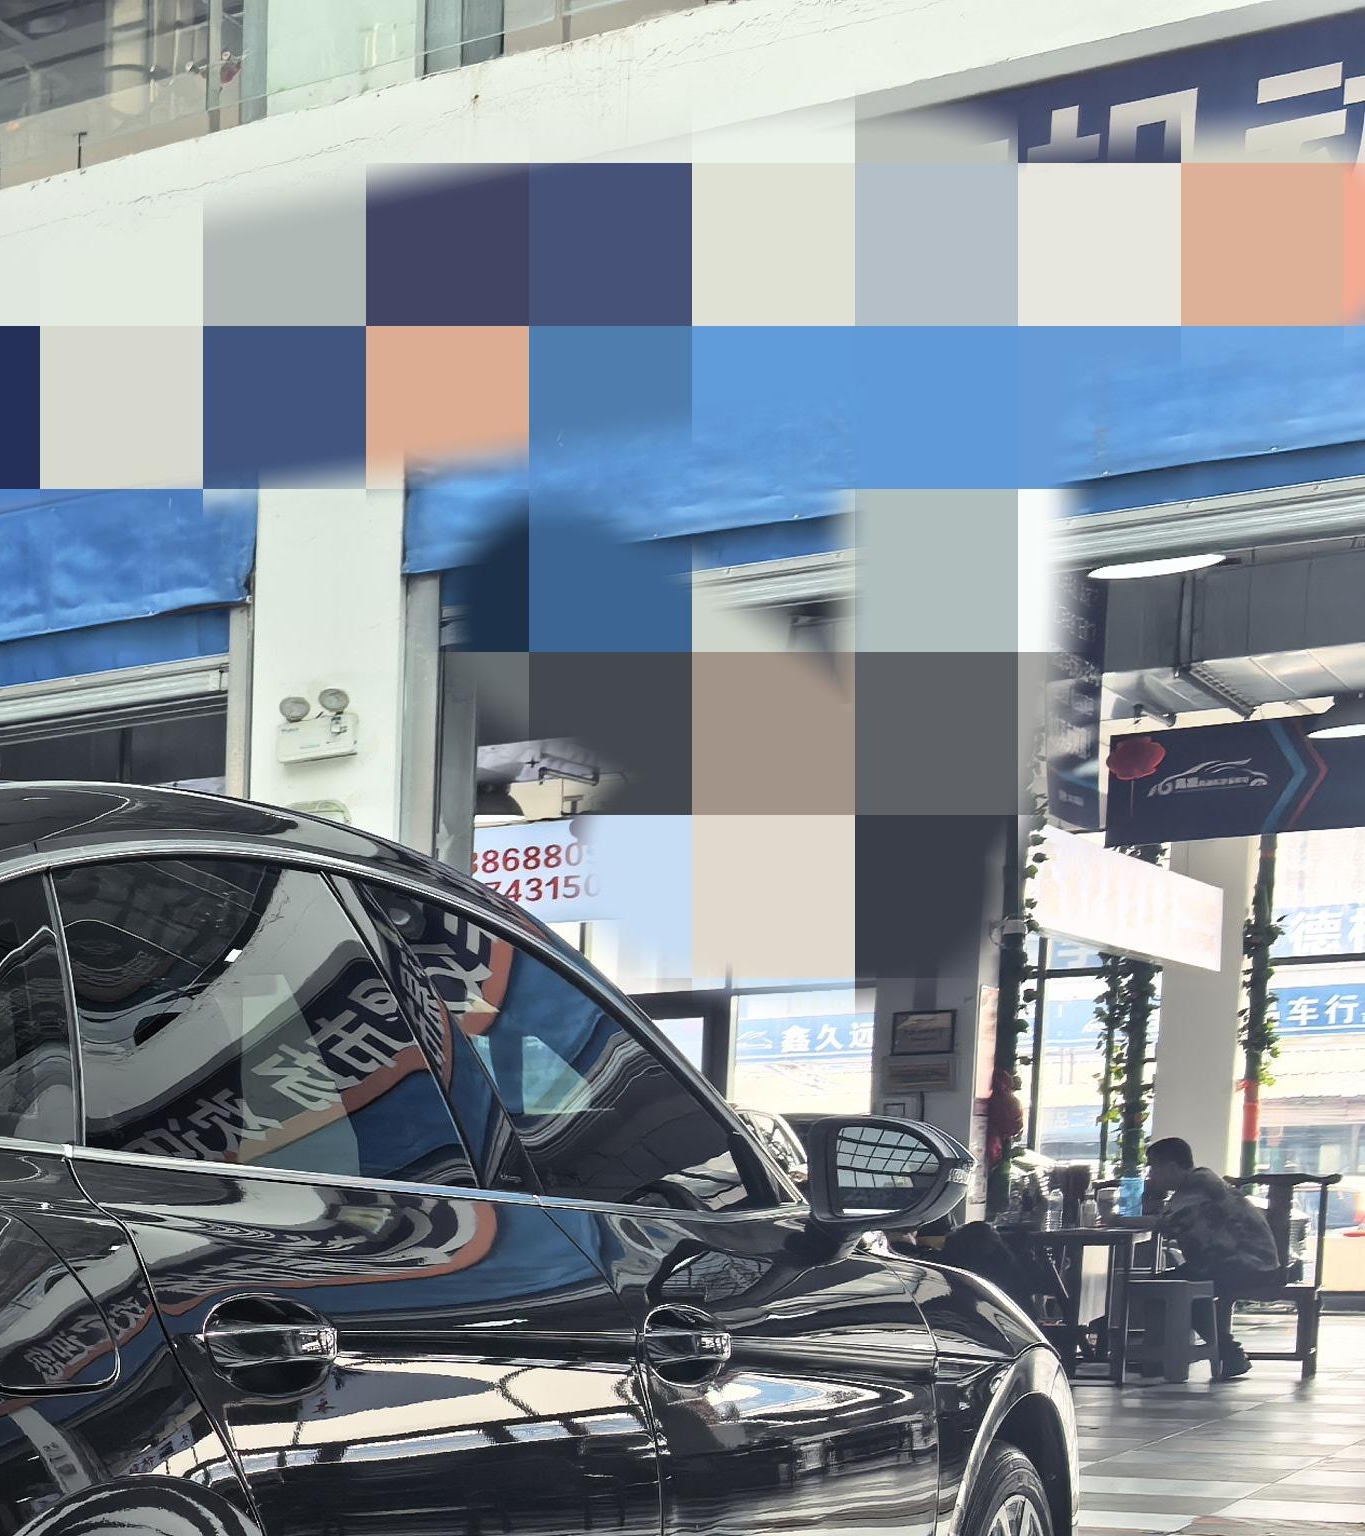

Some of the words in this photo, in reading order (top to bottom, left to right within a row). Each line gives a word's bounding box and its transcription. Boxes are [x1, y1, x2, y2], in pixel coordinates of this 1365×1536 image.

[1266, 994, 1365, 1028] 车行
[780, 1021, 874, 1054] 鑫久远
